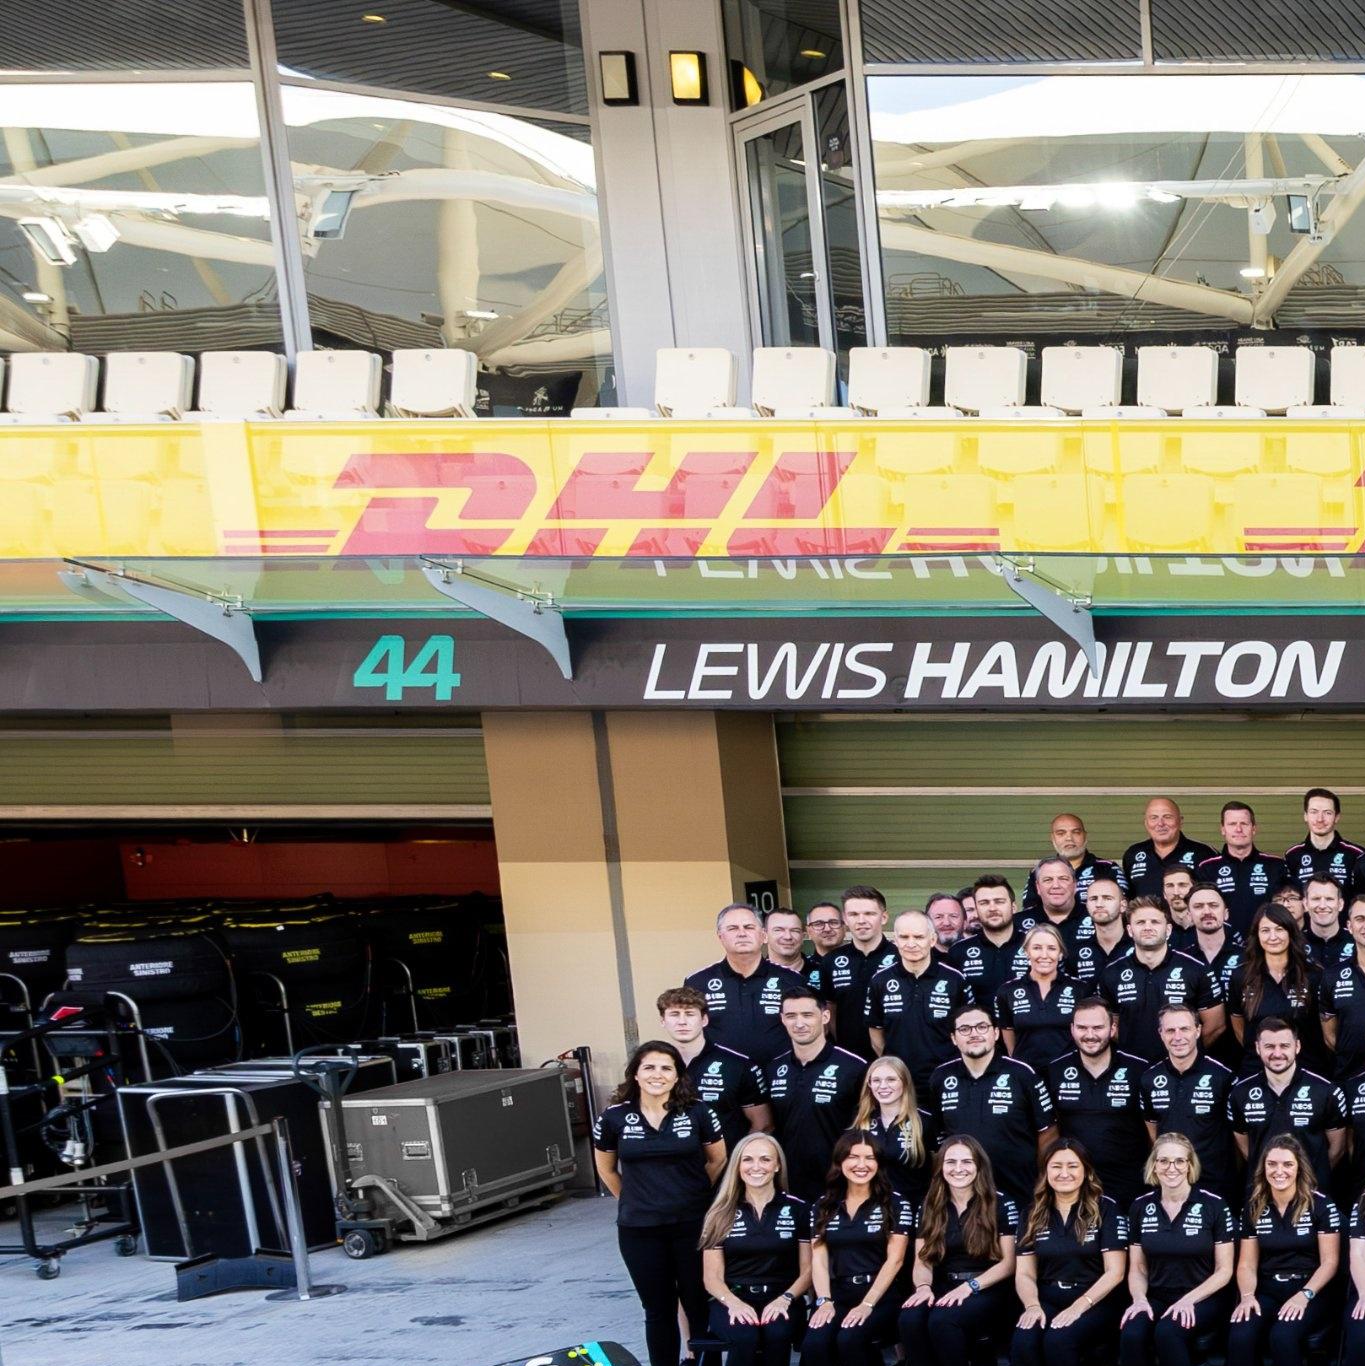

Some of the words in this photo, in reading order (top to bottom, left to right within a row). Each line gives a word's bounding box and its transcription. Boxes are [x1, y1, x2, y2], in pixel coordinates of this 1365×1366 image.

[328, 452, 896, 570] DHL
[354, 635, 461, 700] 44
[644, 642, 892, 699] LEWIS
[904, 641, 1346, 699] HAMILTON
[751, 892, 773, 915] 10
